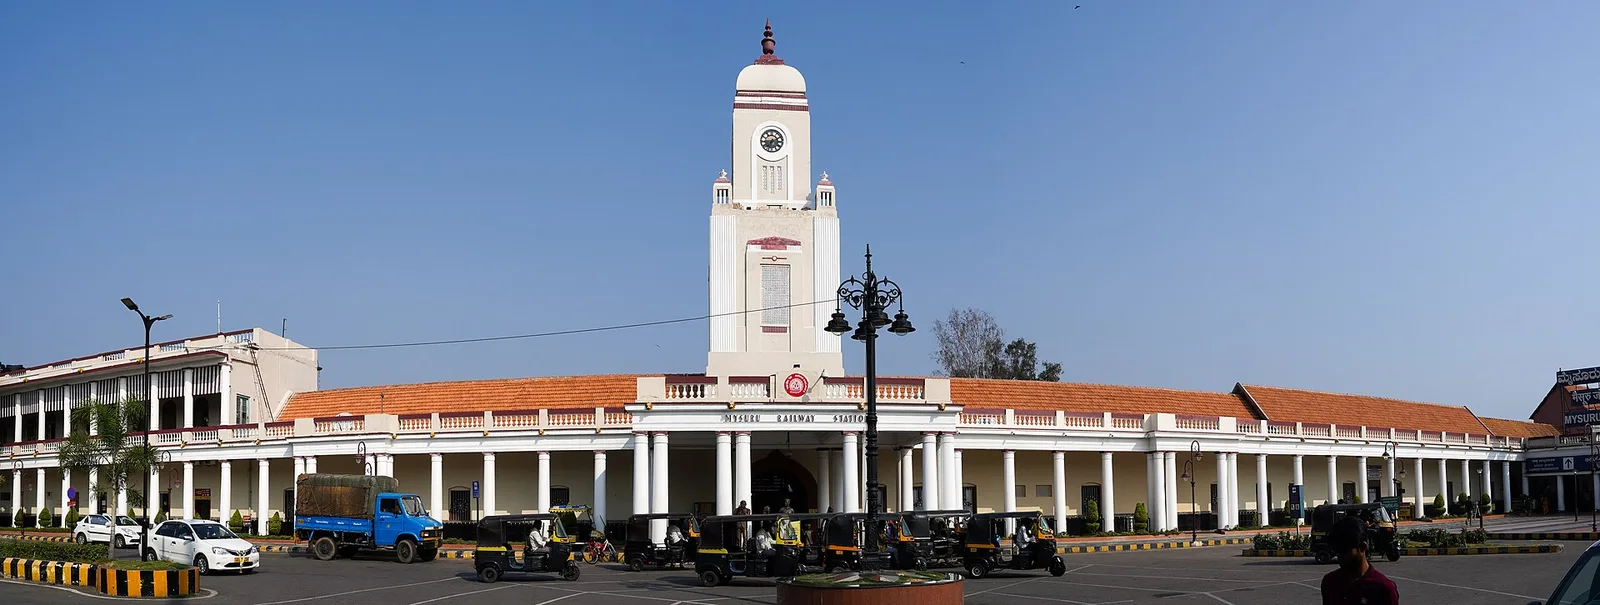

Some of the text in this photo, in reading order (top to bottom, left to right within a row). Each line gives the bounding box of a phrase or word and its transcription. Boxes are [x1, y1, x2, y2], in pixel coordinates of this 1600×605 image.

[724, 414, 868, 423] MYSURU RAILWAY STATIO
[1564, 413, 1600, 425] MYSURU
